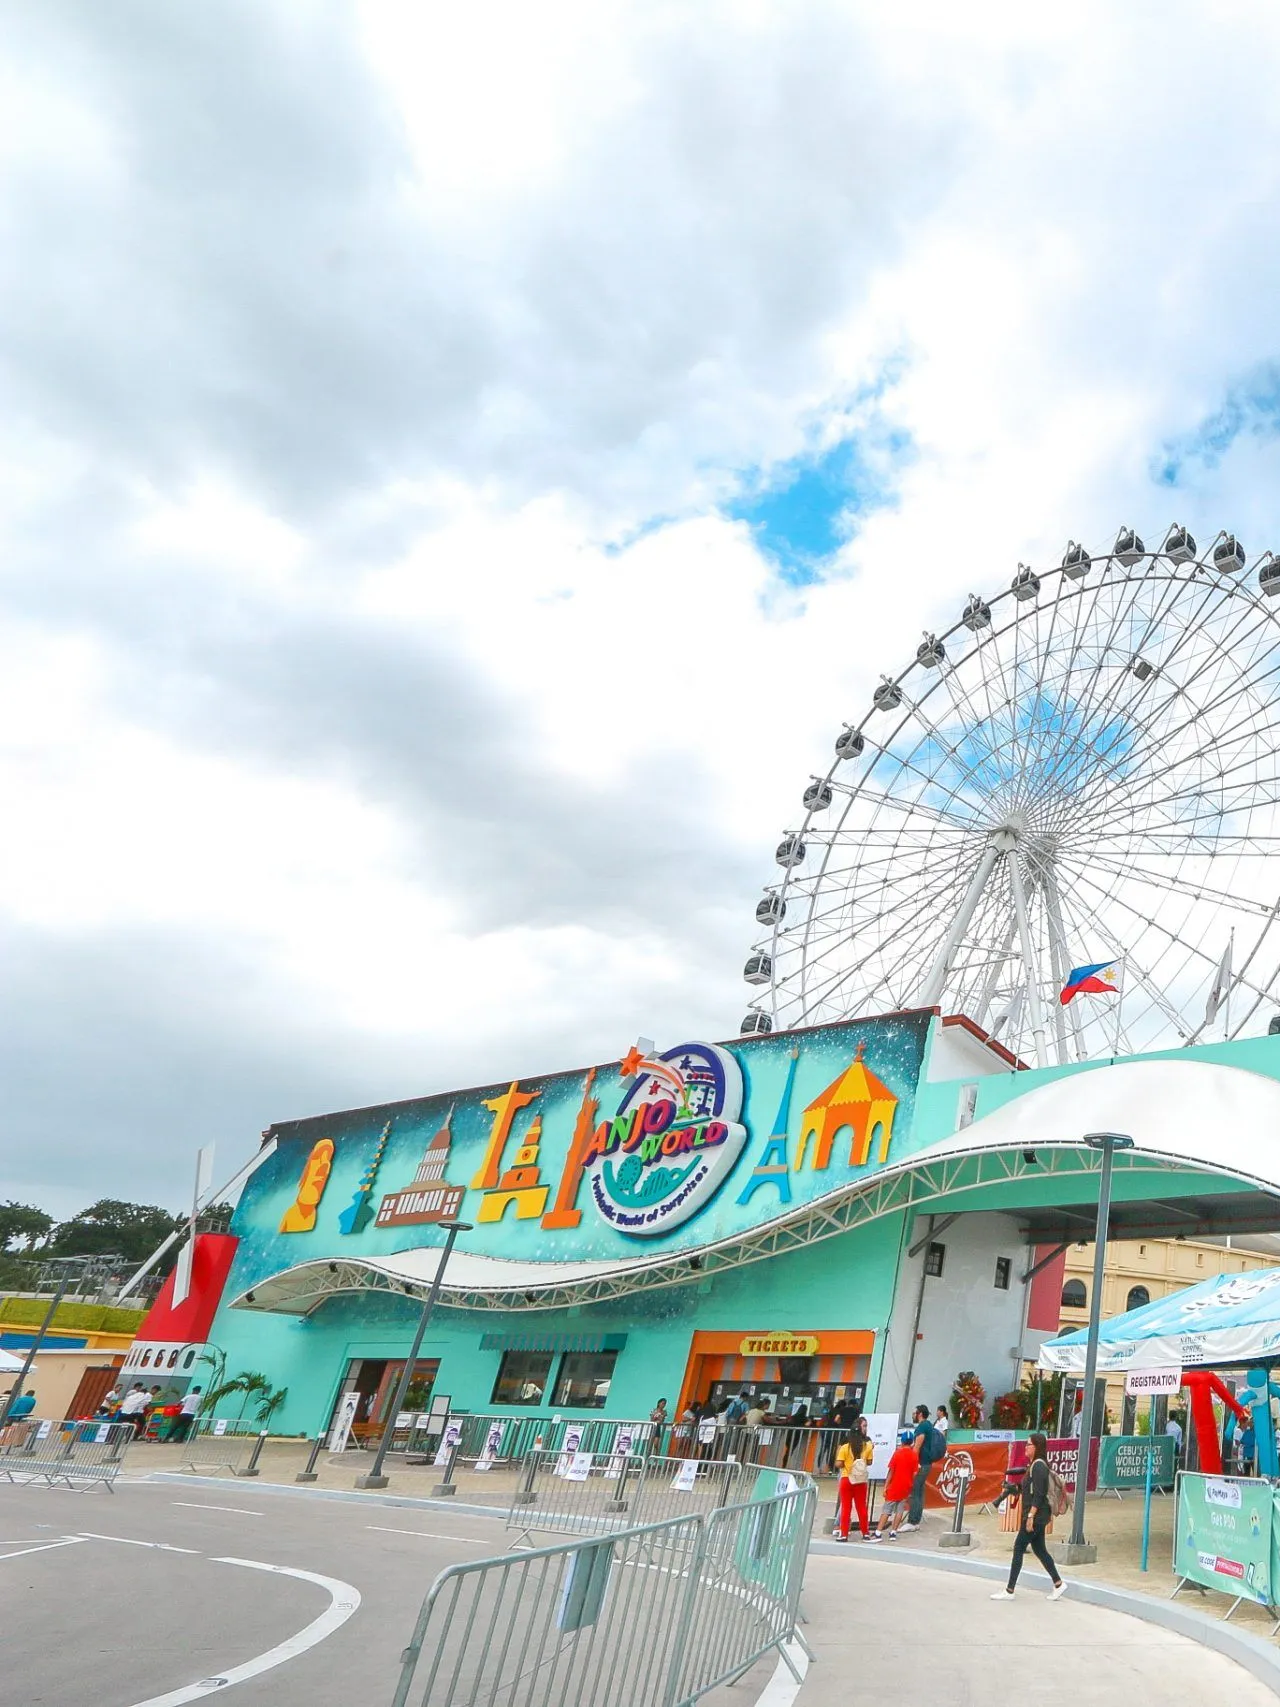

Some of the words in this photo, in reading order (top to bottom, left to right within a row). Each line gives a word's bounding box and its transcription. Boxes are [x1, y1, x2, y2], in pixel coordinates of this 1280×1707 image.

[582, 1099, 676, 1167] ANJO
[641, 1122, 728, 1167] WORLD
[646, 1208, 659, 1222] of
[748, 1340, 807, 1352] TICKETS
[1130, 1374, 1178, 1388] REGISTRATION
[1117, 1445, 1143, 1456] CEBU'S
[1115, 1456, 1141, 1467] WORLD
[1116, 1466, 1141, 1477] THEME
[1212, 1488, 1228, 1499] PayMaya
[1210, 1511, 1222, 1527] Get
[1223, 1512, 1236, 1530] P50
[1205, 1556, 1215, 1567] CODE
